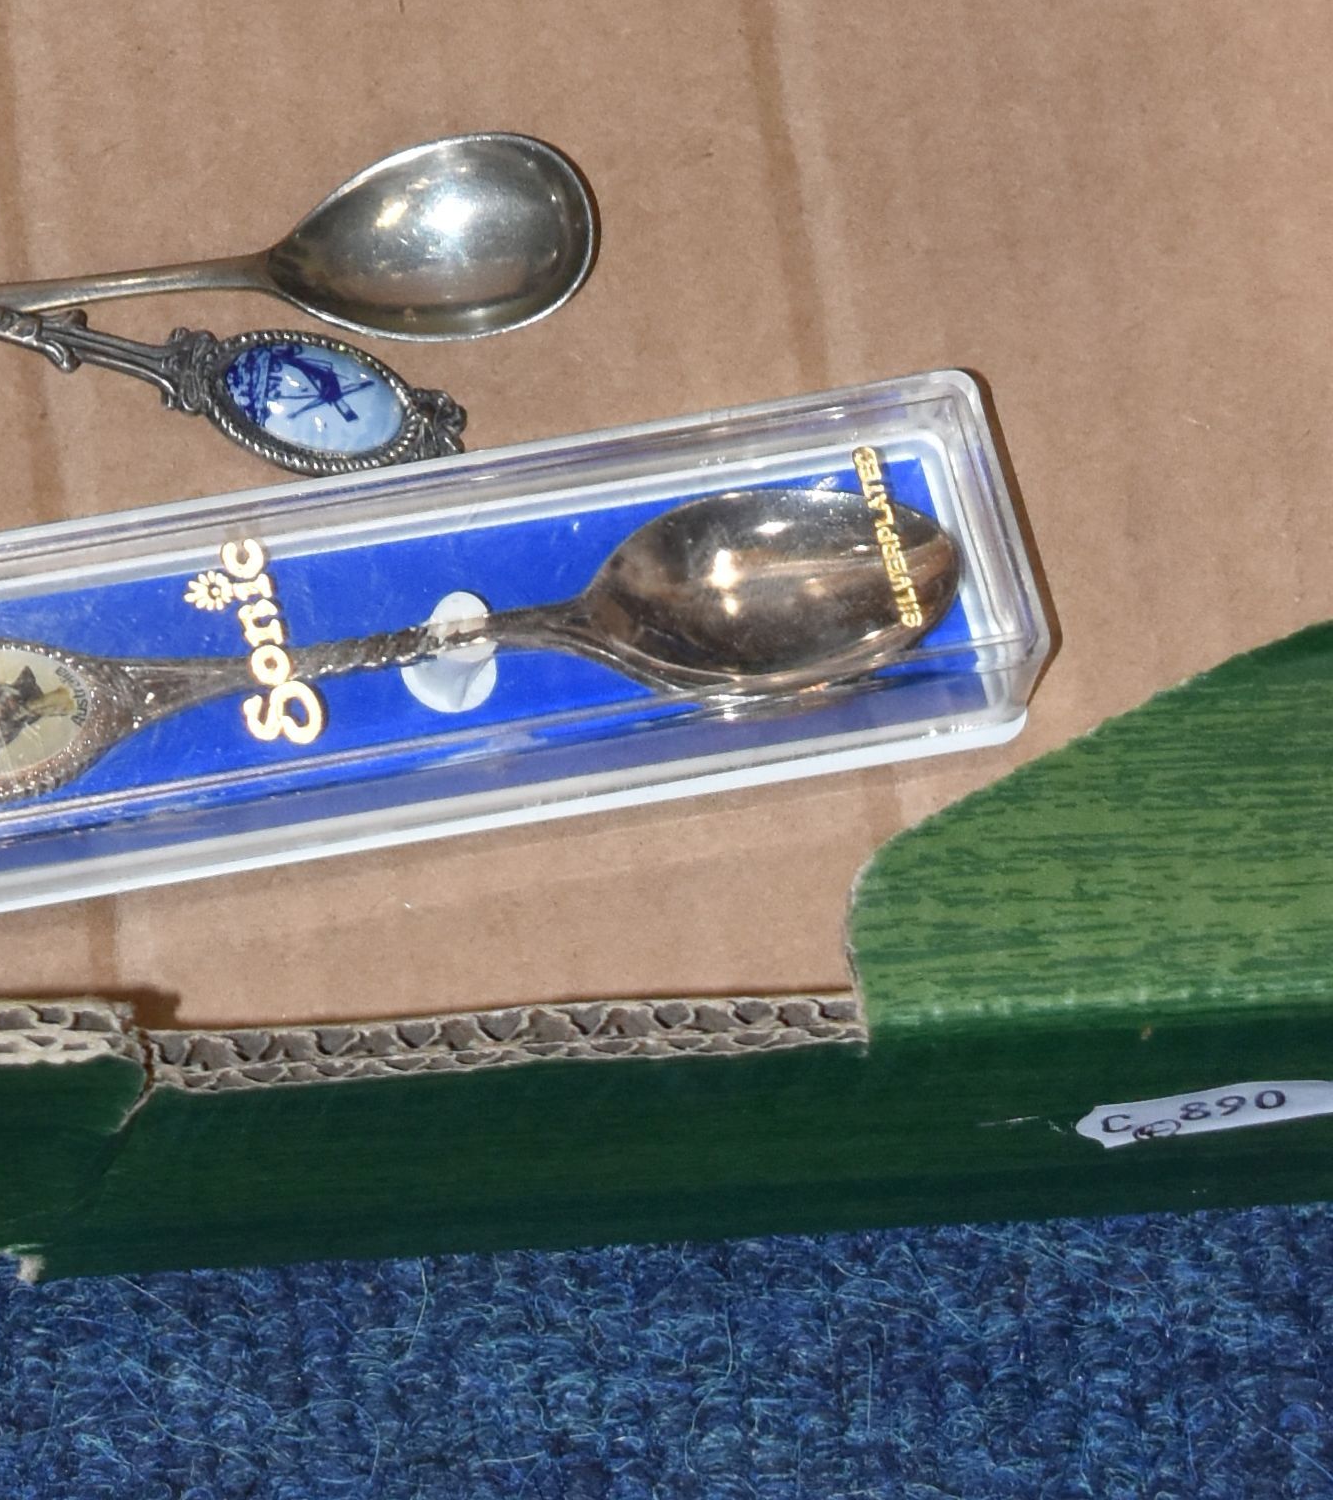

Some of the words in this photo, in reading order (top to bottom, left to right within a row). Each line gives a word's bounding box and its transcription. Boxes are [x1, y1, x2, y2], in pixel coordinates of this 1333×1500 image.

[187, 537, 324, 745] Sonic
[55, 665, 89, 727] Australia
[1179, 1089, 1287, 1121] 890
